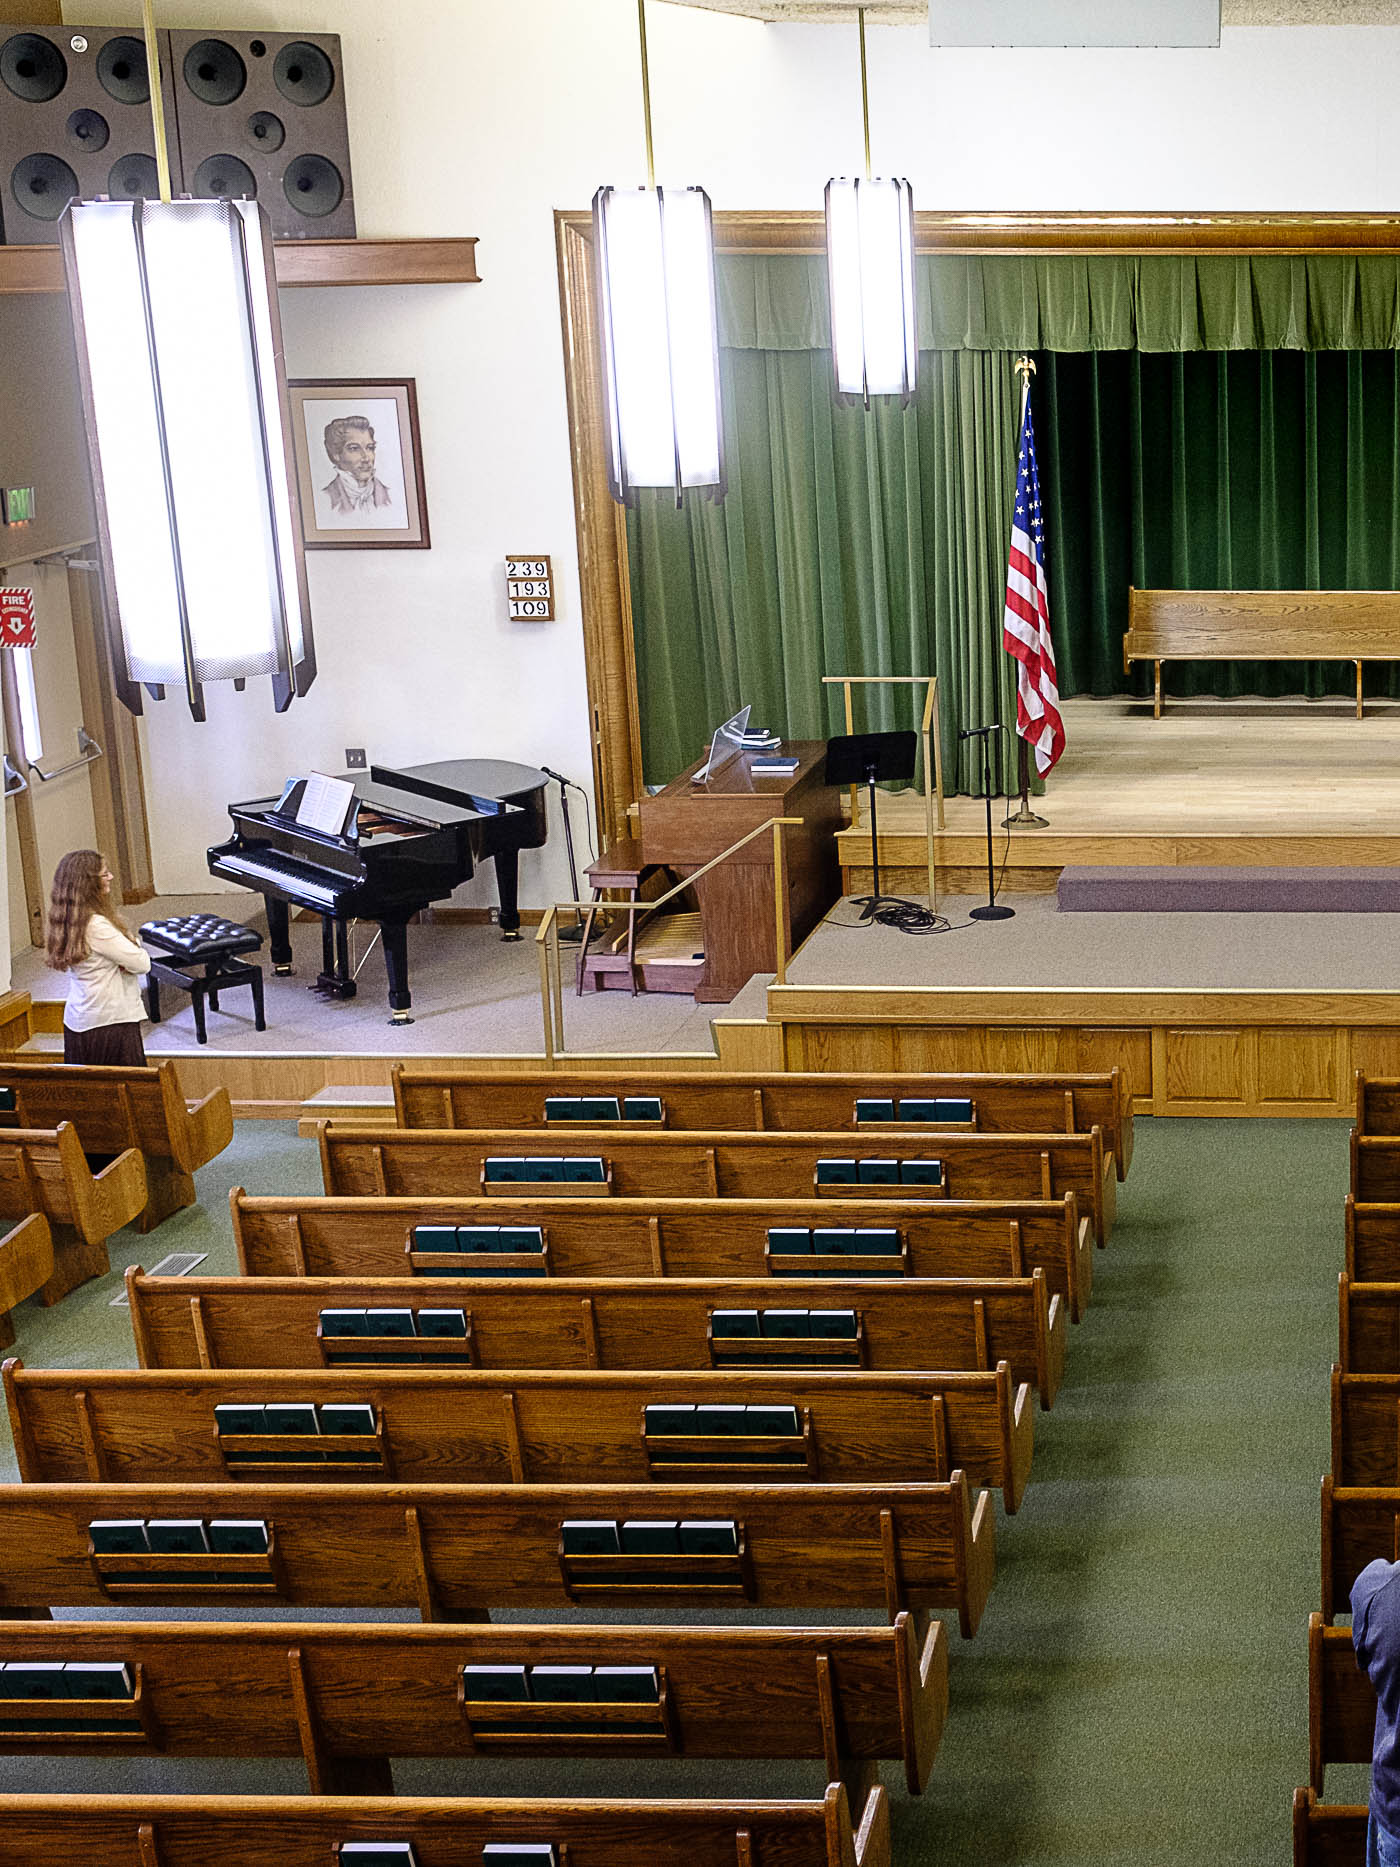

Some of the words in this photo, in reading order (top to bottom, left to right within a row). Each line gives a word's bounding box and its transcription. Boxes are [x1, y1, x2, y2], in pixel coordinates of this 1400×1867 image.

[507, 562, 545, 576] 239
[512, 582, 548, 597] 193
[2, 596, 25, 605] FIRE
[512, 601, 546, 615] 109
